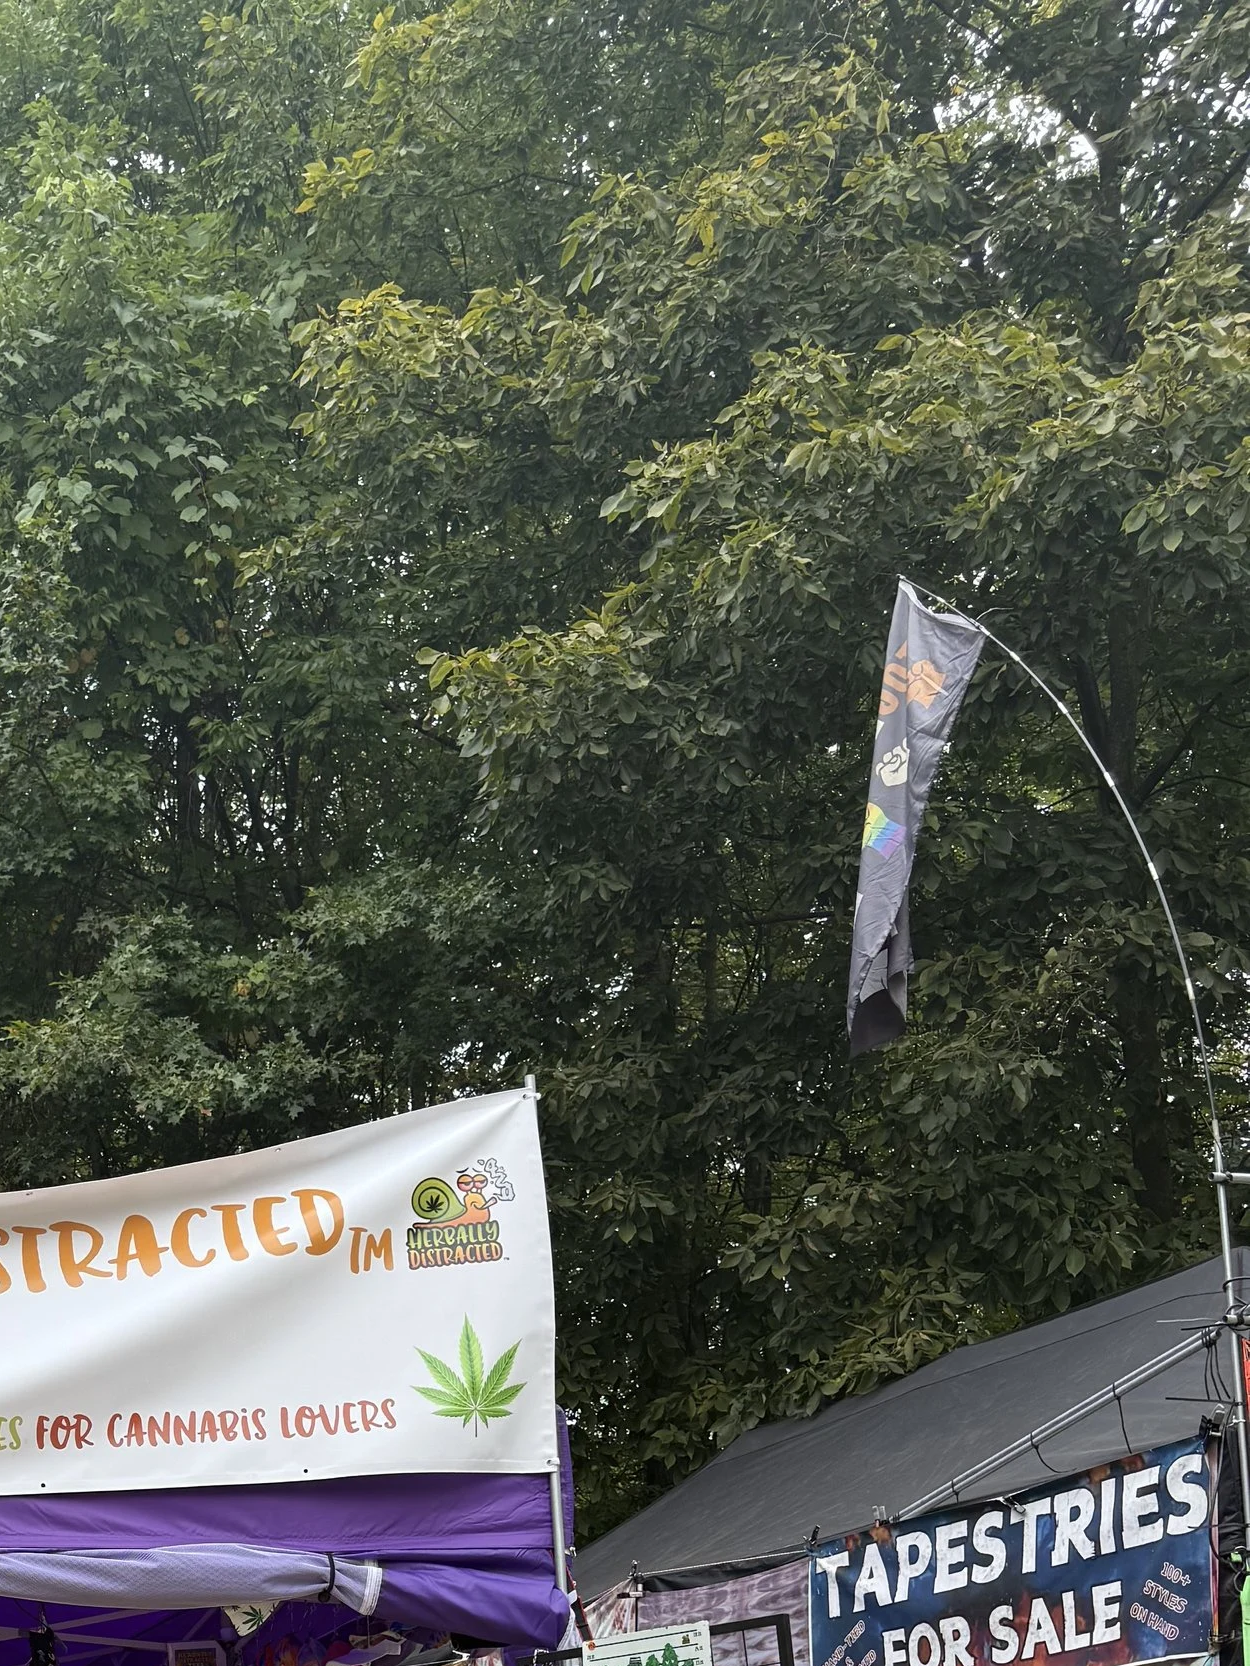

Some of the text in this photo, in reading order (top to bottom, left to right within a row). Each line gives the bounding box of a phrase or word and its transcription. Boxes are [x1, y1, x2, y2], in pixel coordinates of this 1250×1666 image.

[349, 1226, 394, 1274] TM
[407, 1222, 498, 1249] HERBALLY
[35, 1412, 94, 1450] FOR
[279, 1397, 397, 1436] LOVERS
[815, 1453, 1210, 1619] TAPESTRIES
[1160, 1562, 1191, 1587] 100+
[1143, 1580, 1188, 1613] STYLES
[988, 1580, 1122, 1665] SALE
[1130, 1603, 1179, 1641] ON HAND
